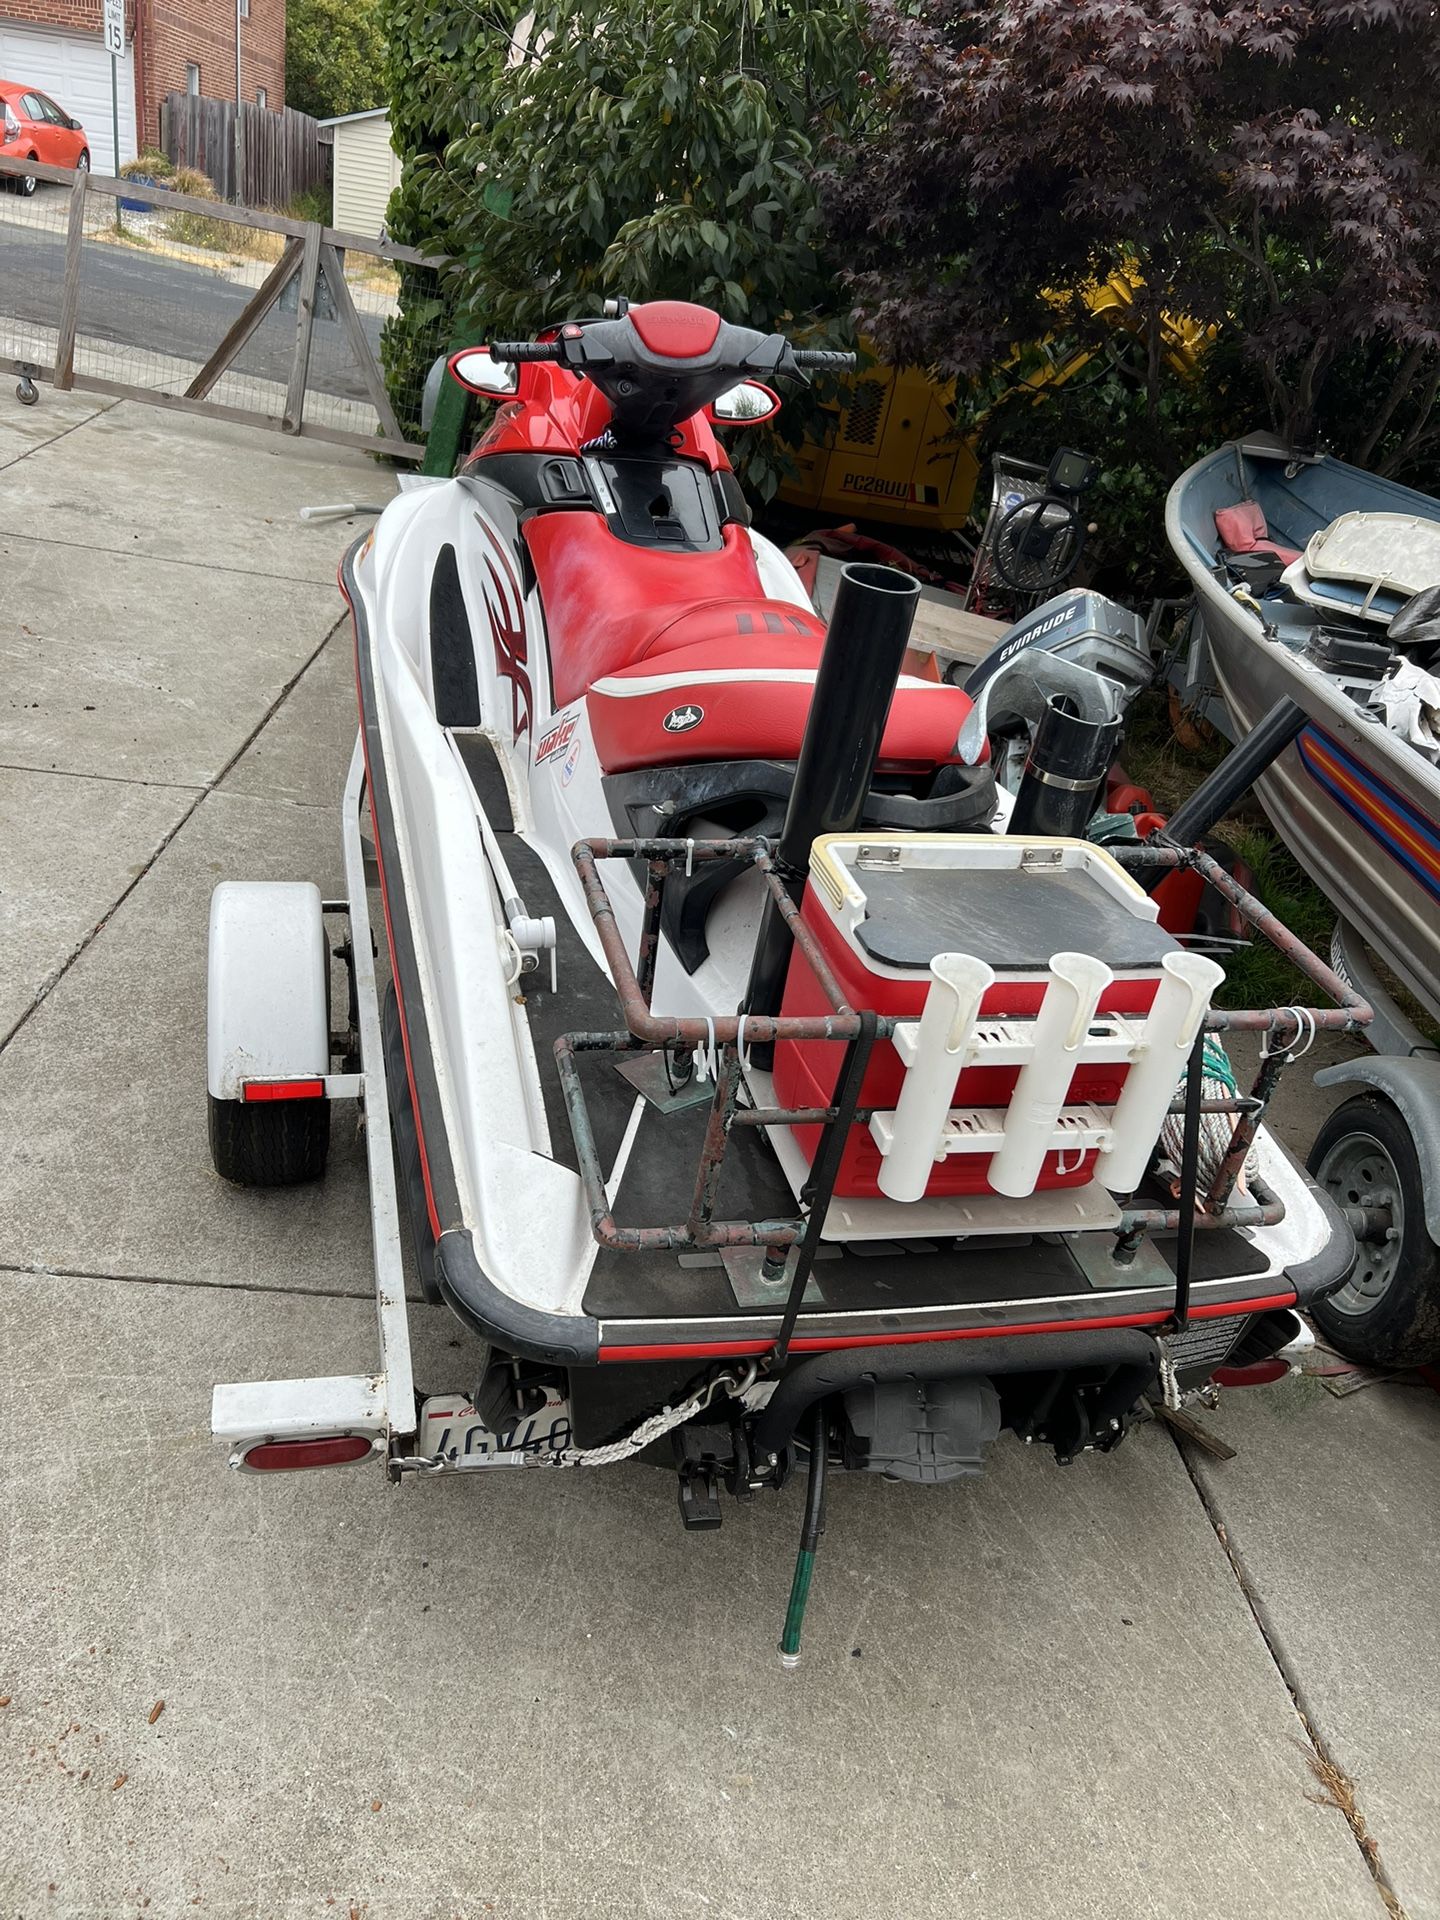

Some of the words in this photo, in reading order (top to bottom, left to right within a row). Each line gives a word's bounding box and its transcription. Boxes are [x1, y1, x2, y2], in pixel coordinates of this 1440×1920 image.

[107, 8, 121, 22] LIMIT
[108, 23, 122, 49] 15
[842, 473, 909, 497] PC28UU
[1000, 606, 1076, 662] EVINRUDE
